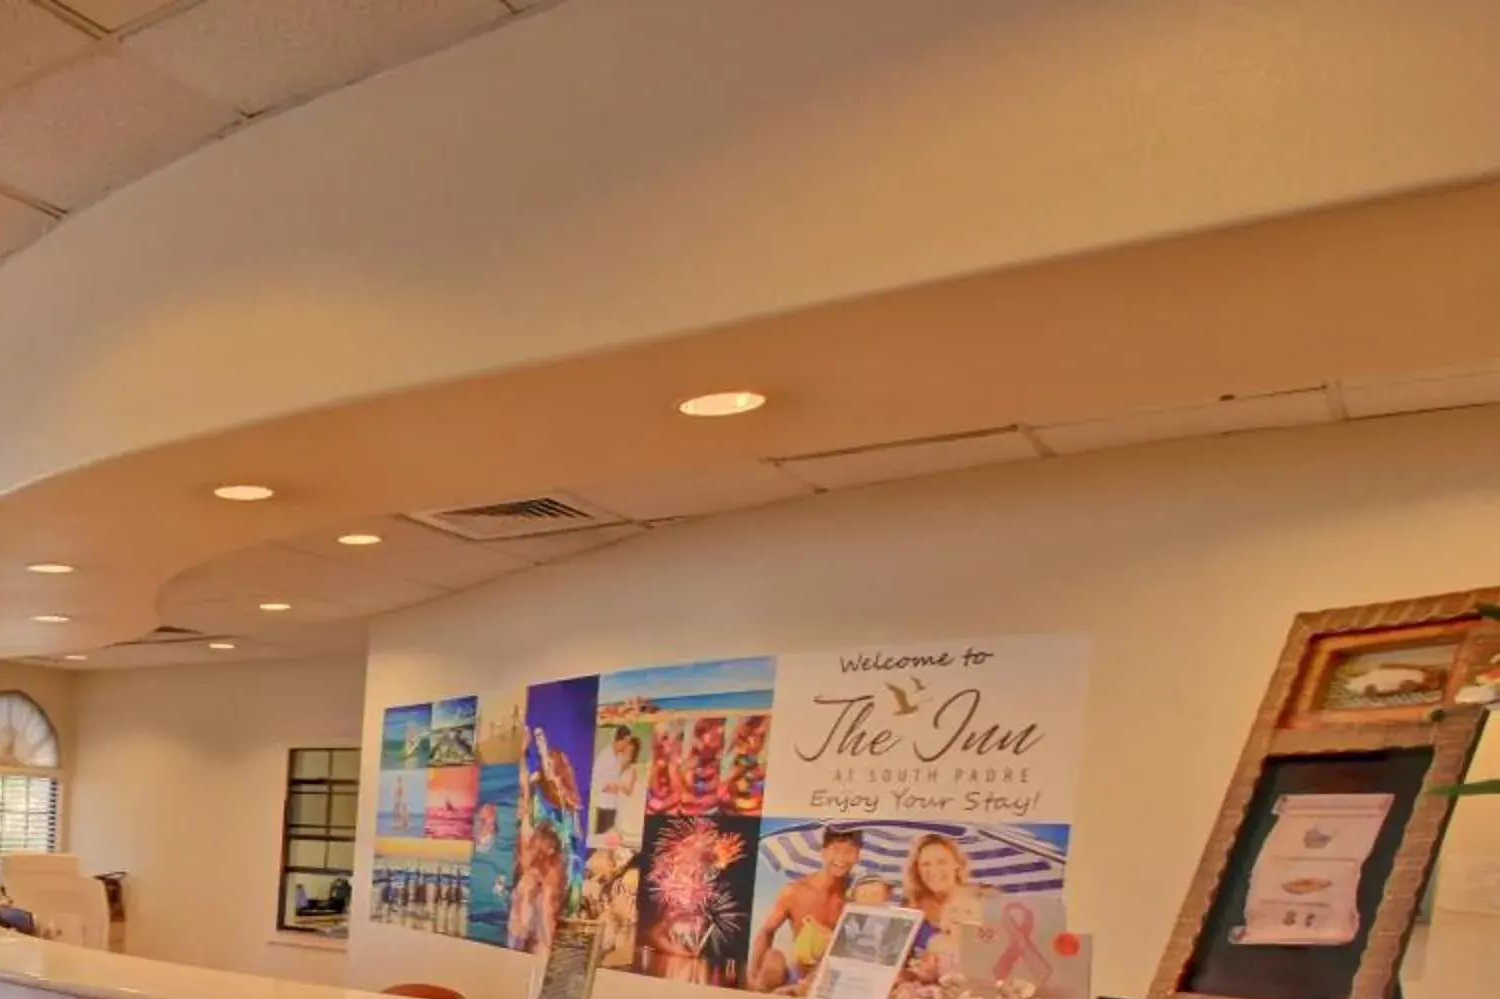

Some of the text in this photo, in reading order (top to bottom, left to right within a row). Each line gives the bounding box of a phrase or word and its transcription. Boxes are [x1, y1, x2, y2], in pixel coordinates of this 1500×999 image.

[840, 646, 994, 673] Welcome to
[794, 688, 1046, 763] The Inn
[832, 767, 1030, 784] AT SOUTH PADRE
[809, 788, 1041, 817] Enjoy Your Stay!
